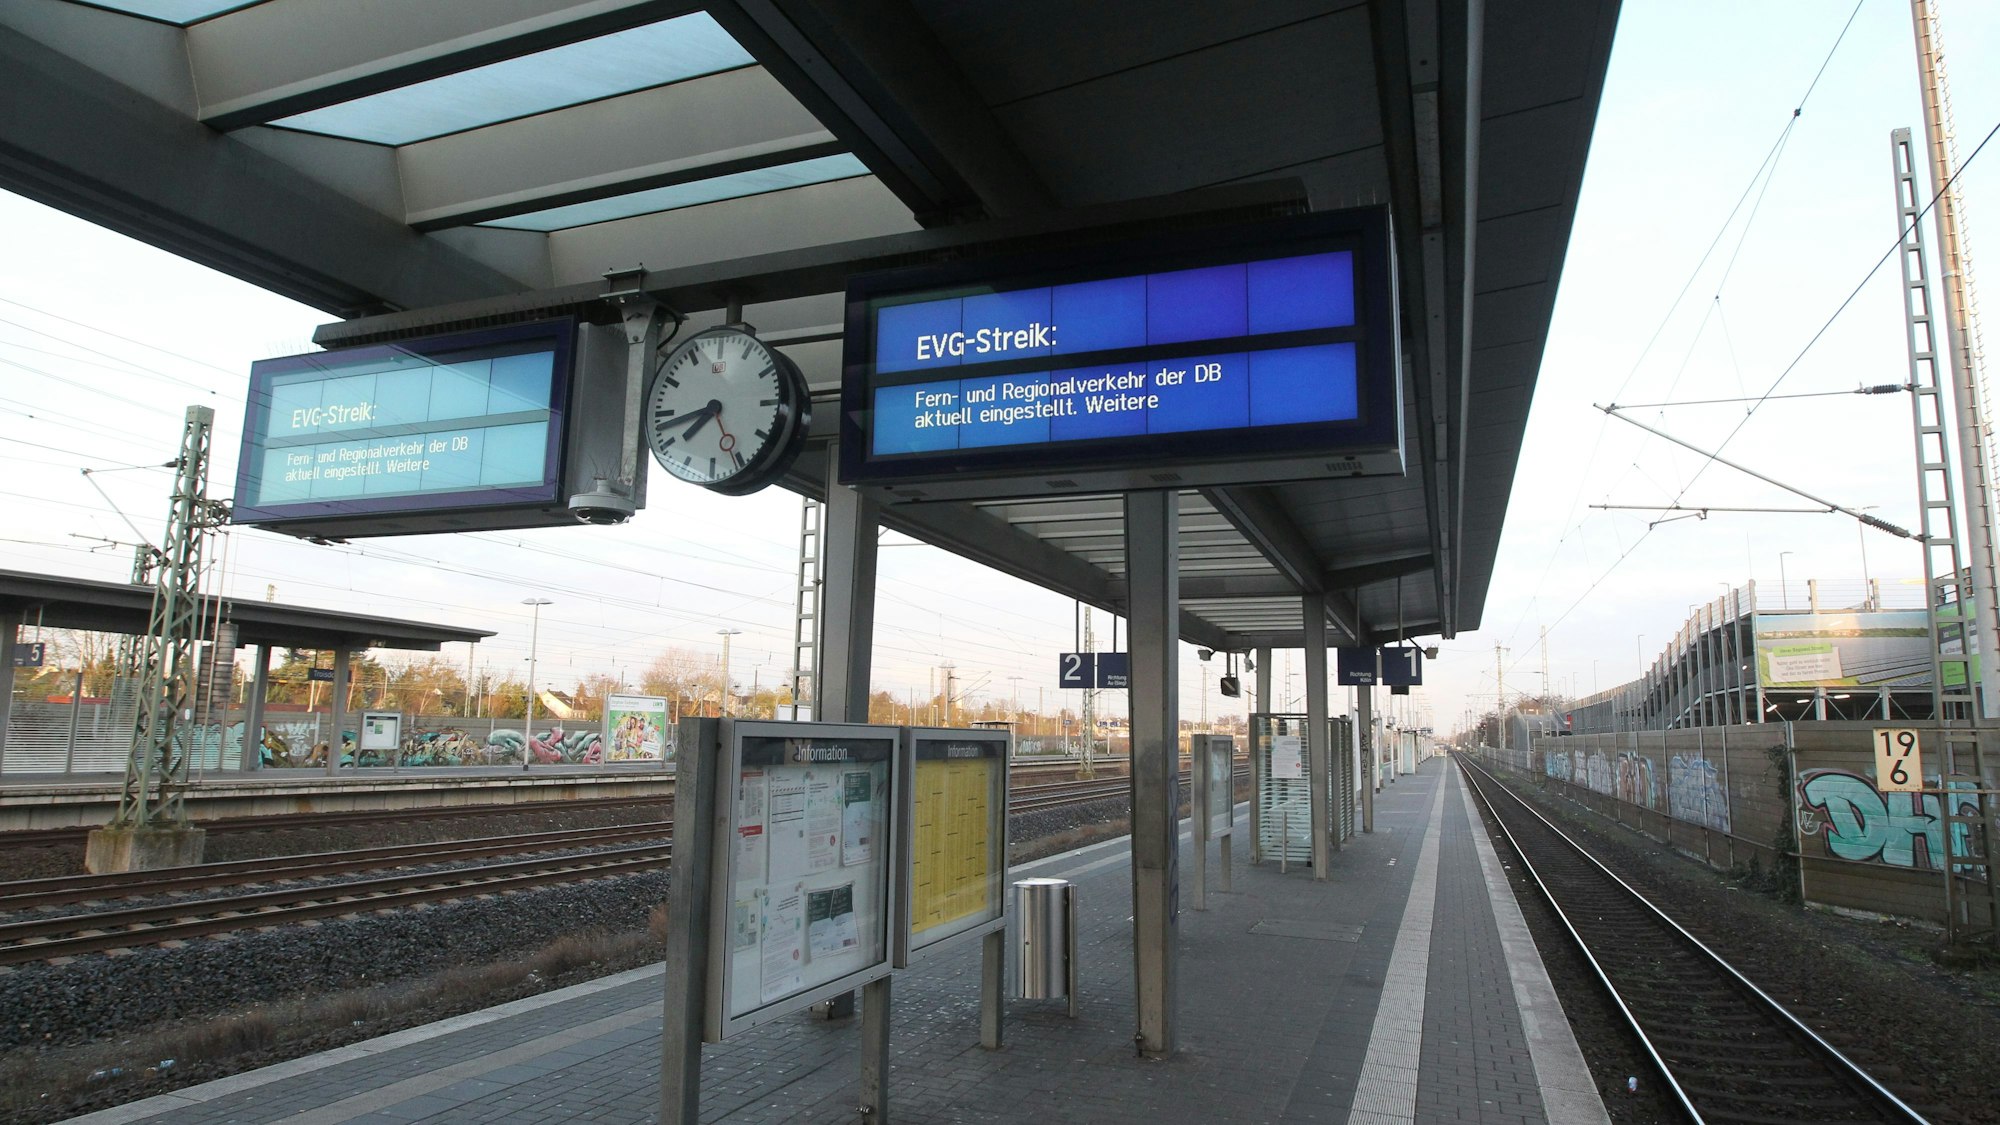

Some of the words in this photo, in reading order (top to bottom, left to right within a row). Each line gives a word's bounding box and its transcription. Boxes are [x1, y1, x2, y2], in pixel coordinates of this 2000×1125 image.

[917, 322, 1057, 360] EVG-Streik:
[915, 391, 959, 408] Fern-
[966, 384, 996, 403] und
[1003, 371, 1147, 402] Regionalverkehr
[1155, 368, 1186, 387] der
[1194, 363, 1222, 383] DB
[292, 402, 377, 429] EVG-Streik:
[915, 407, 972, 429] aktuell
[980, 397, 1077, 425] eingestellt.
[1085, 393, 1159, 414] Weitere
[287, 453, 314, 466] Fern-
[318, 449, 336, 463] und
[339, 442, 424, 464] Regionalverkehr
[429, 440, 448, 453] der
[451, 436, 469, 451] DB
[285, 466, 320, 482] aktuell
[324, 461, 382, 481] eingestellt.
[386, 458, 430, 473] Weitere
[31, 644, 40, 661] 5
[1404, 648, 1417, 677] 1
[1064, 654, 1082, 681] 2
[797, 745, 848, 761] Information
[947, 744, 978, 758] Information
[1880, 731, 1915, 757] 19
[1889, 759, 1909, 785] 6
